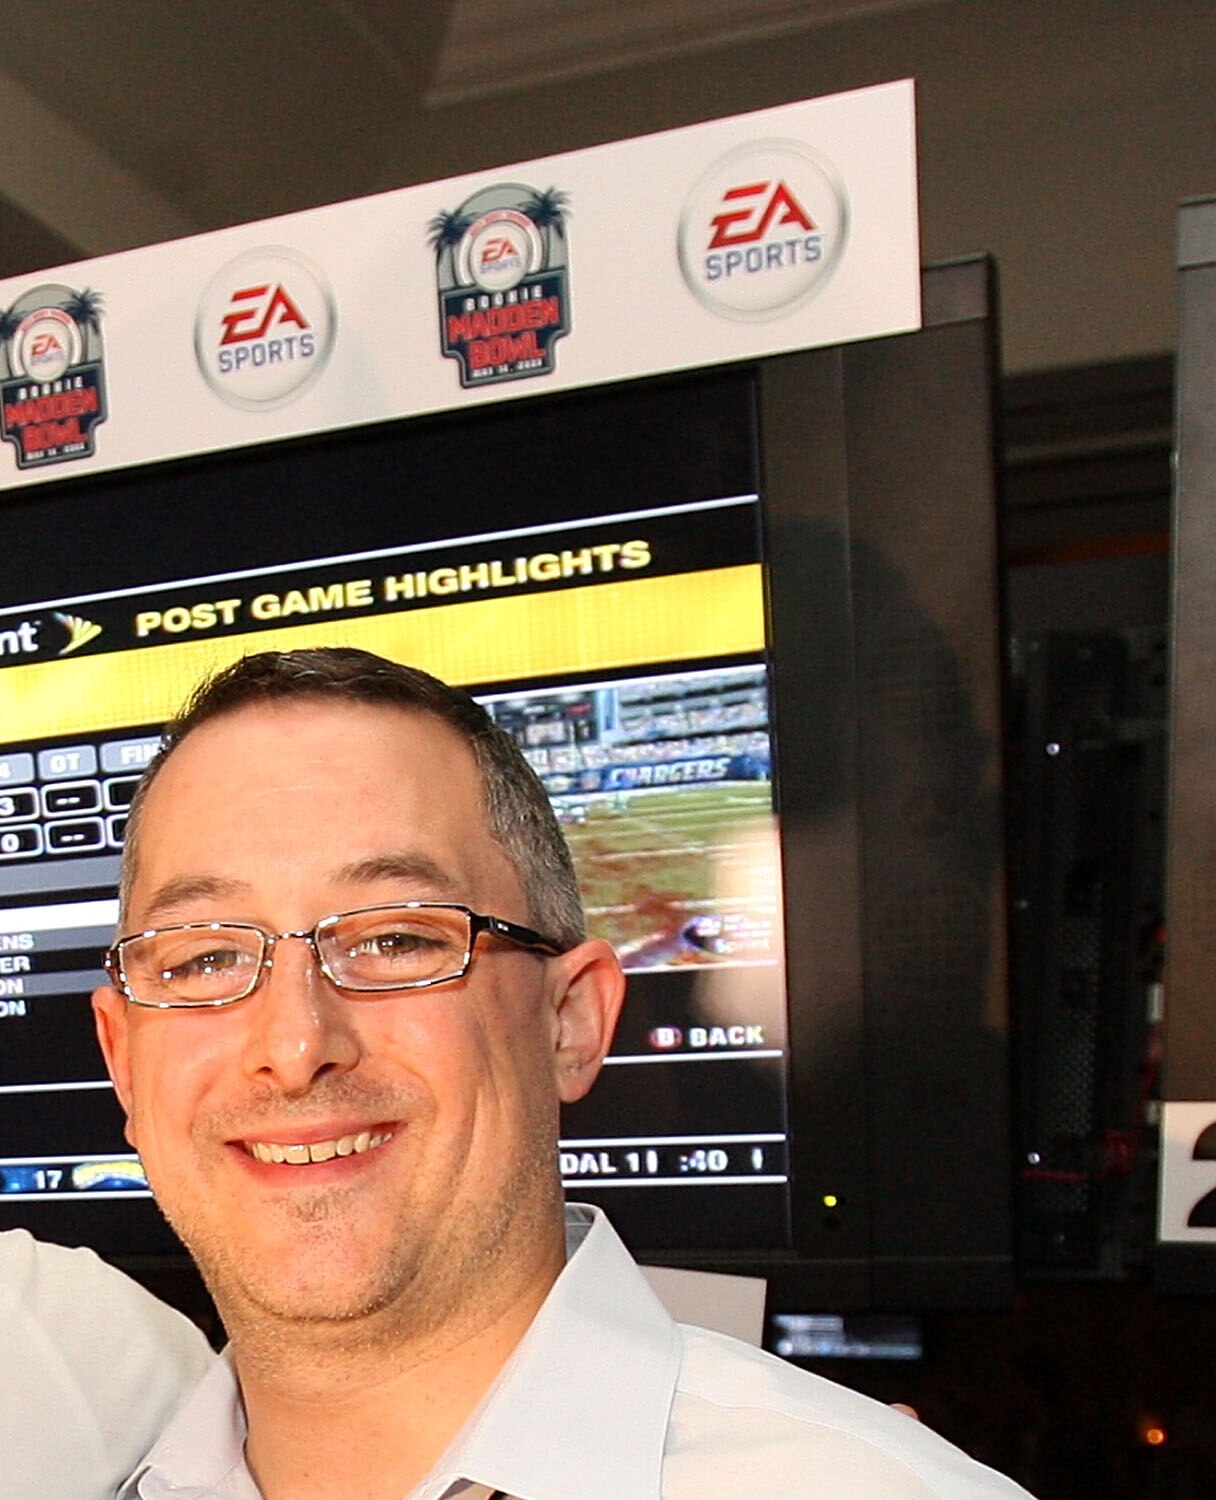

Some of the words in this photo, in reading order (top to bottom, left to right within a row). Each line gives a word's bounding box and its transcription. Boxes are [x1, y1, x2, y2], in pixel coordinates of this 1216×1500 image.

[707, 180, 816, 249] EA
[481, 237, 518, 262] EA
[705, 235, 823, 279] SPORTS
[219, 283, 308, 345] EA
[465, 285, 543, 311] ROOKIE
[448, 297, 559, 343] MADDEN
[32, 333, 62, 356] EA
[218, 334, 315, 374] SPORTS
[469, 331, 545, 369] BOWL
[136, 600, 241, 637] POST
[251, 580, 374, 619] GAME
[385, 540, 651, 602] HIGHLIGHTS
[50, 753, 80, 773] OT
[690, 1025, 764, 1047] BACK
[35, 1169, 64, 1190] 17
[560, 1152, 617, 1175] DAL
